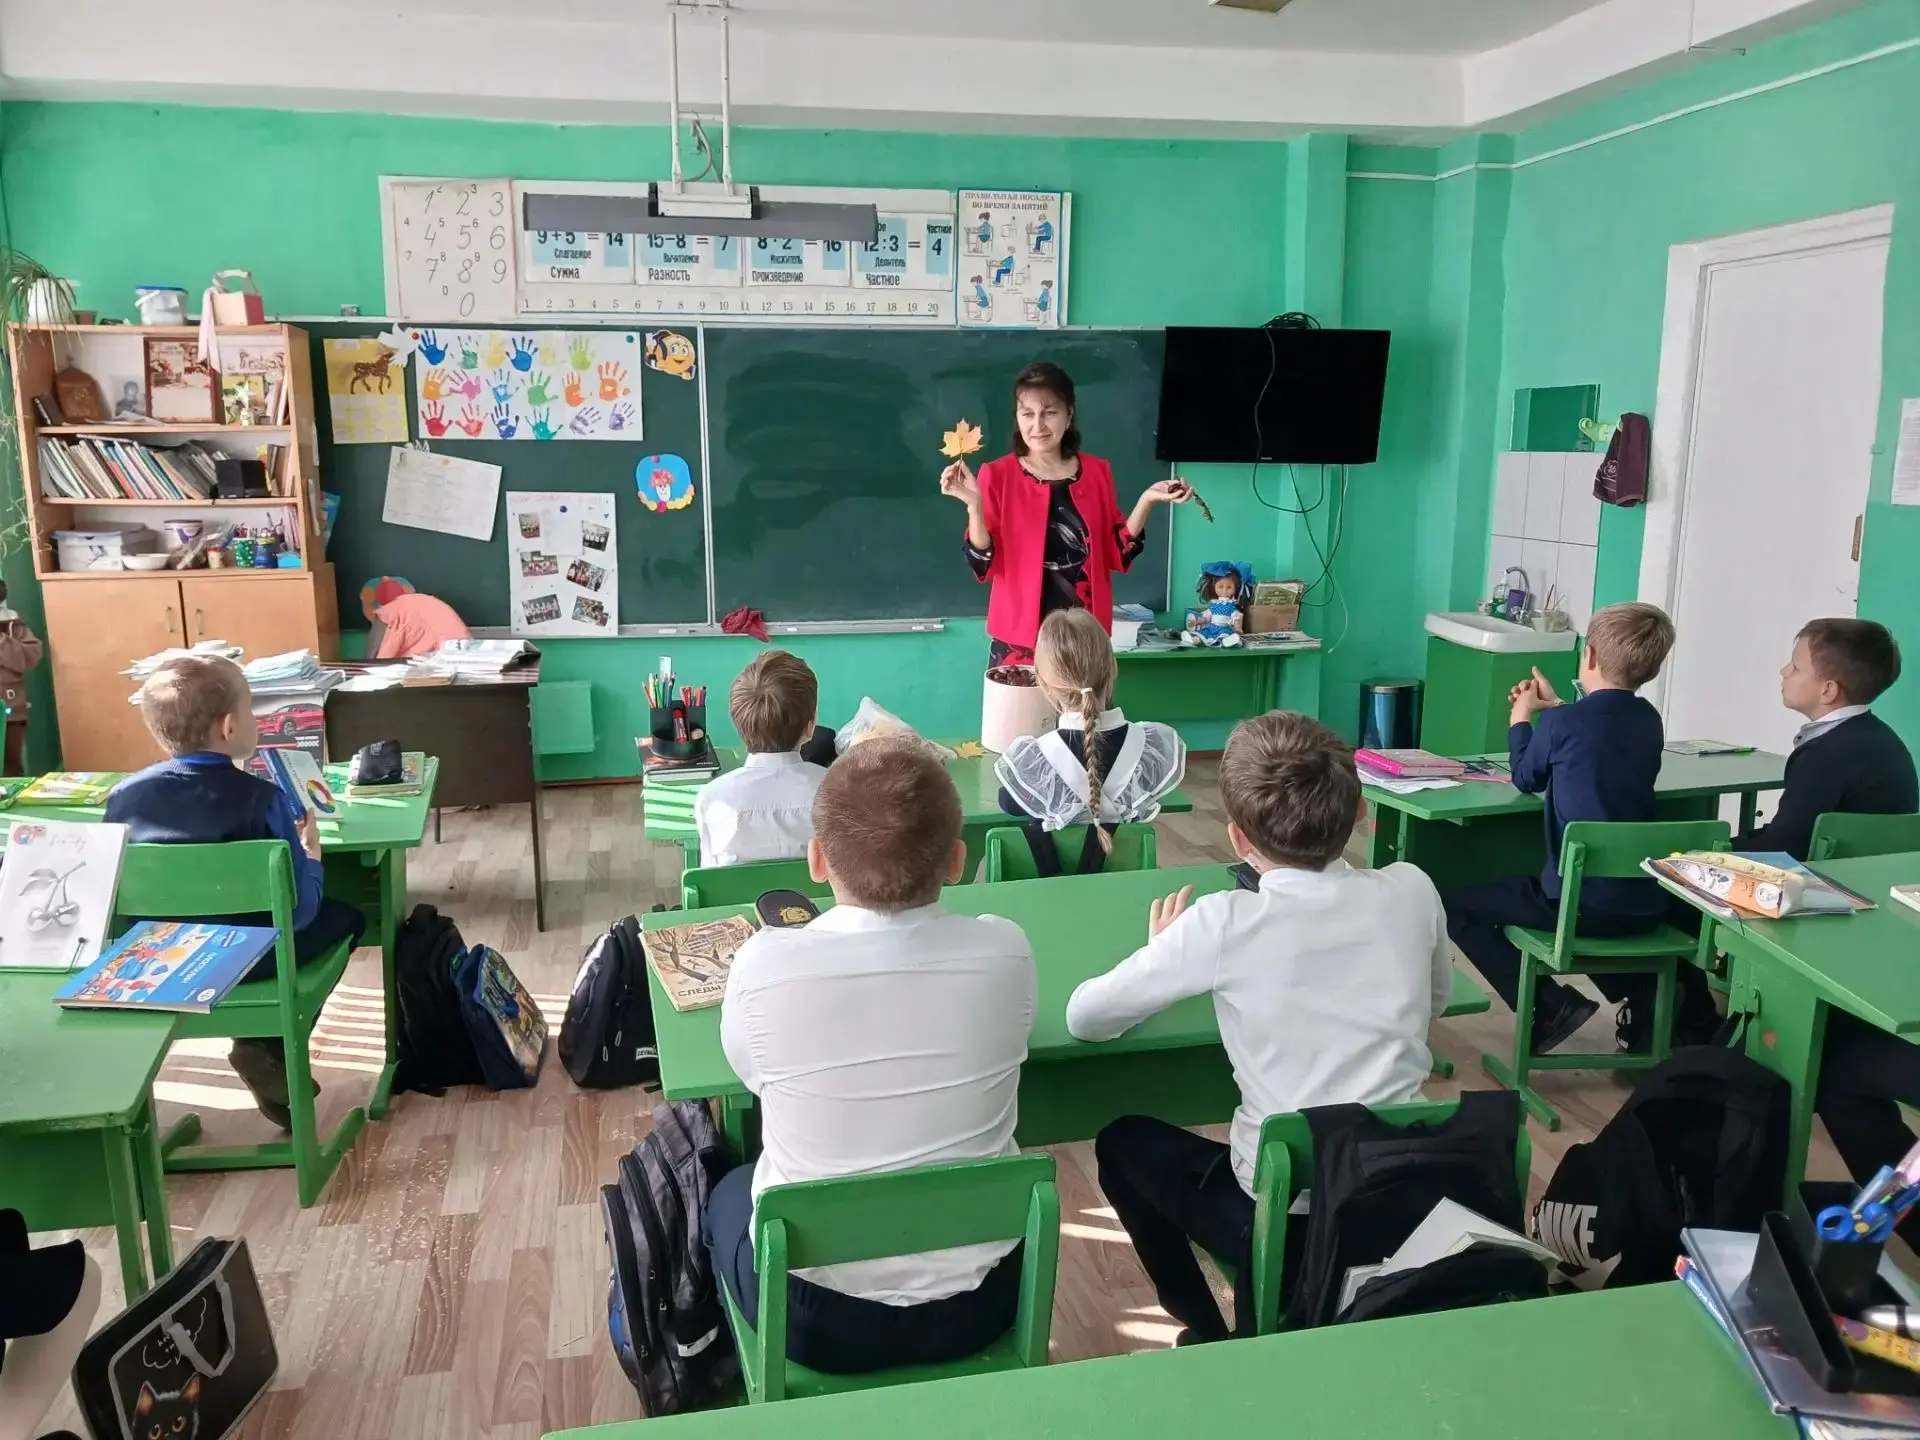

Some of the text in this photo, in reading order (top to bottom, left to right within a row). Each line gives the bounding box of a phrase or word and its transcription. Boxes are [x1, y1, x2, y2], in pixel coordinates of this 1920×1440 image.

[471, 183, 478, 194] 3
[424, 189, 504, 217] 1 2 3
[964, 192, 1056, 202] ПРАВИЛЬНАЯ ПОСАДКА
[972, 201, 1049, 211] ВО ВРЕМЯ ЗАНЯТИЙ
[403, 216, 479, 228] 4 5 6
[926, 223, 952, 234] Частное
[423, 223, 506, 250] 4 5 6
[606, 232, 624, 246] 14
[719, 235, 729, 251] 7
[554, 248, 592, 259] Слагаемое
[931, 238, 943, 256] 4
[439, 251, 447, 262] 8
[473, 251, 481, 262] 9
[663, 252, 700, 264] Вычитаемое
[770, 254, 803, 265] Множитель
[874, 256, 906, 268] Делитель
[425, 257, 507, 285] 7 8 9
[550, 266, 580, 279] Сумма
[648, 267, 691, 281] Разность
[751, 270, 804, 284] Произведение
[866, 273, 900, 286] Частное
[442, 285, 449, 296] 0
[460, 291, 475, 317] 0
[525, 299, 939, 312] 1 2 3 4 5 6 7 8 9 10 11 12 13 14 15 16 17 18 19 20
[1538, 1200, 1598, 1269] NIKE
